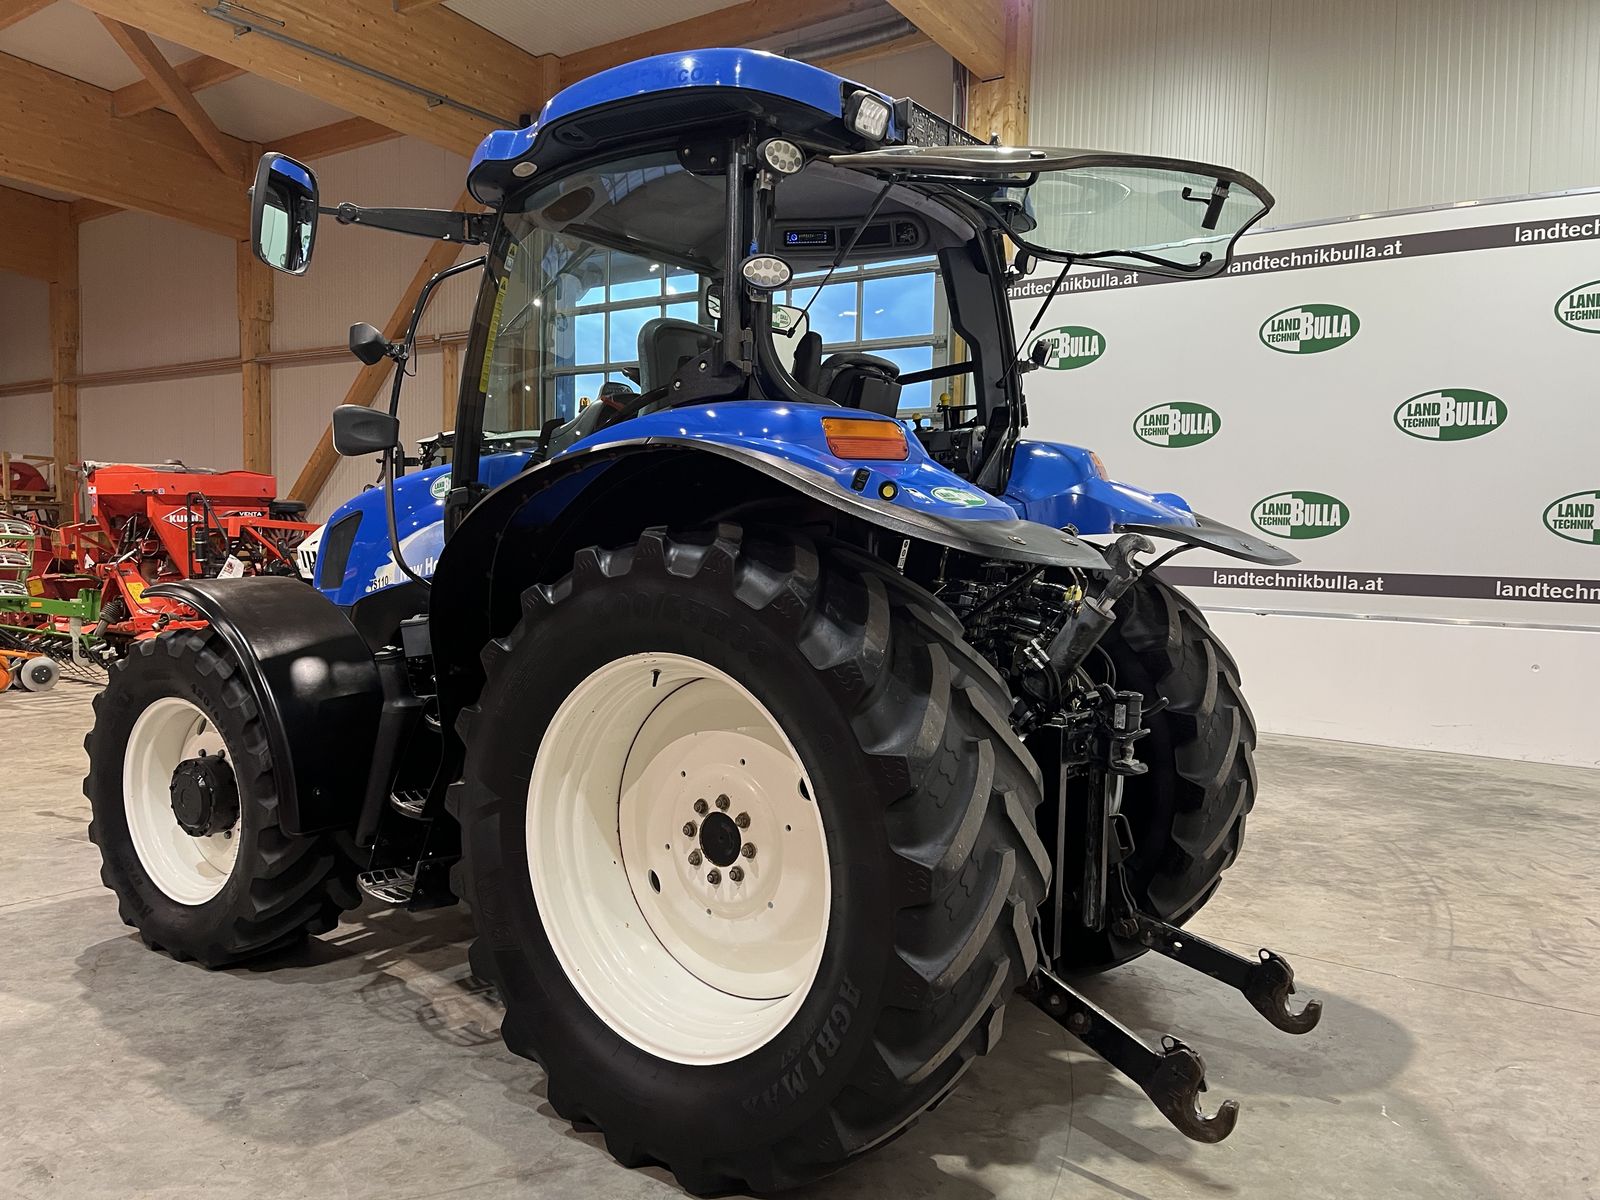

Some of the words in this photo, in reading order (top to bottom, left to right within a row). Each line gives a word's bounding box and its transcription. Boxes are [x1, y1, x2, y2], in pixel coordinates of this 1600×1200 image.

[1007, 272, 1139, 298] andtecnikbulla.at
[1564, 309, 1600, 321] TECHNI
[1271, 318, 1300, 332] LAND
[1300, 312, 1351, 341] BULLA
[1267, 332, 1300, 343] TECHNIK
[1059, 333, 1100, 358] BULLA
[1407, 402, 1441, 417] LAND
[1440, 396, 1498, 427] BULLA
[1143, 414, 1169, 426] LAND
[1168, 409, 1214, 436] BULLA
[1402, 417, 1440, 428] TECHNIK
[1140, 427, 1169, 436] TECHNIK
[1262, 503, 1291, 516] LAND
[1291, 498, 1341, 526] BULLA
[1557, 503, 1595, 518] LAND
[1258, 516, 1291, 526] TECHNIK
[1552, 519, 1594, 530] TECHNIK
[1213, 571, 1384, 591] landtechnikbulla.at
